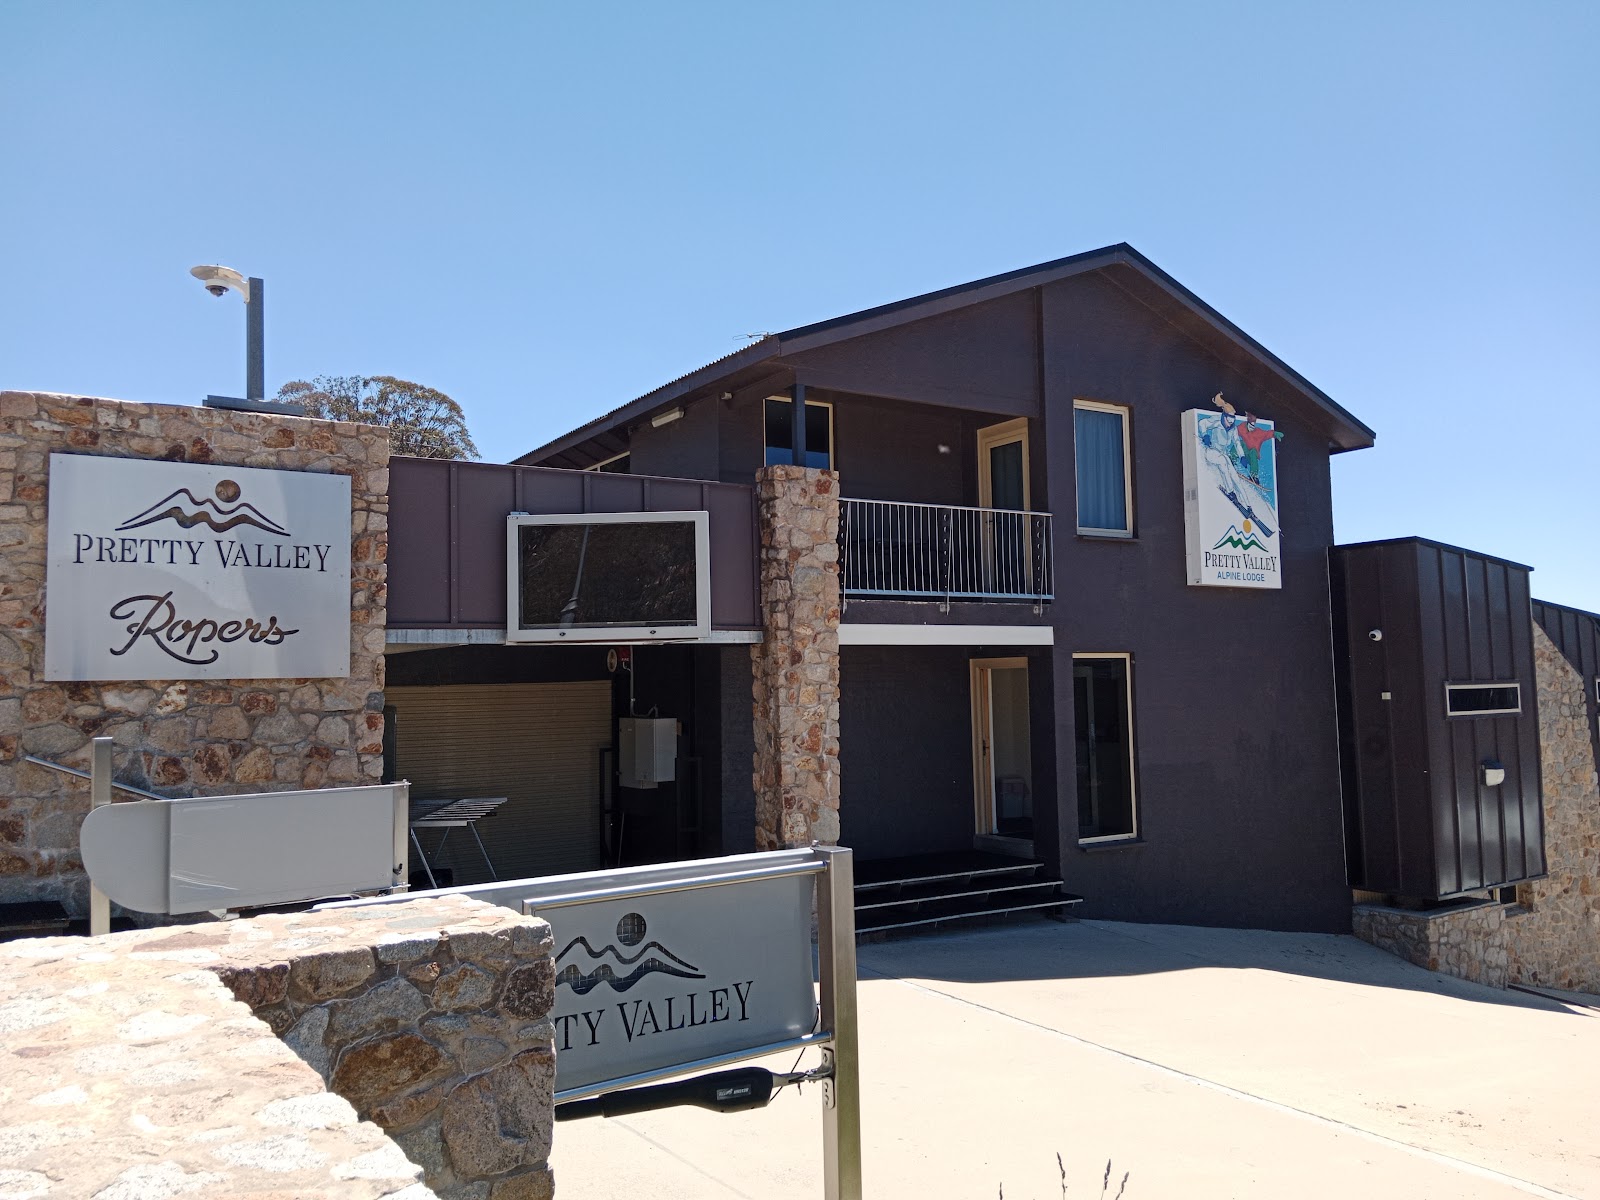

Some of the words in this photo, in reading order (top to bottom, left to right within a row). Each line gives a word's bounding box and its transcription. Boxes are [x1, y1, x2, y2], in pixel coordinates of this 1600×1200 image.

[72, 533, 205, 565] PRETTY
[214, 539, 332, 572] VALLEY
[1204, 551, 1241, 569] PRETTY
[1242, 553, 1277, 572] VALLEY
[1217, 571, 1241, 581] ALPINE
[1242, 572, 1265, 582] LODGE
[110, 590, 300, 665] Ropers
[616, 980, 754, 1043] VALLEY
